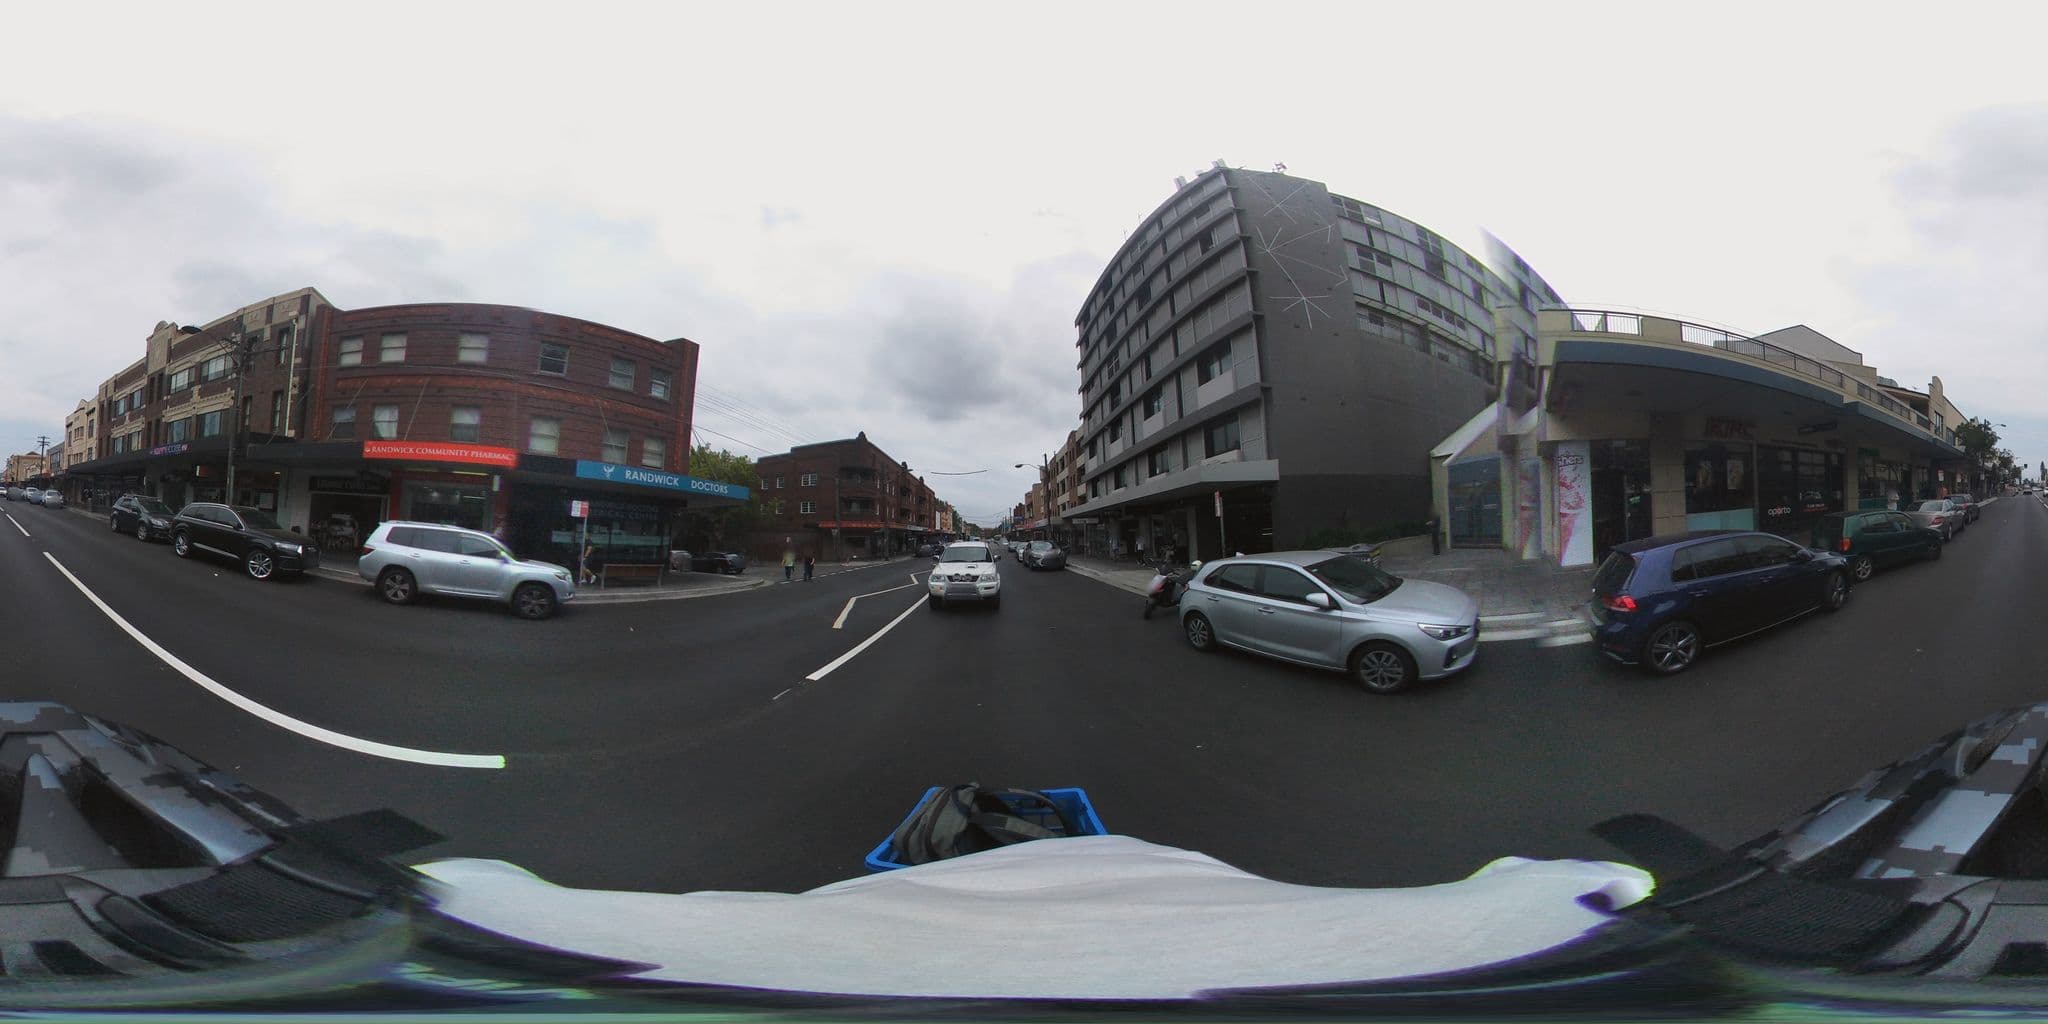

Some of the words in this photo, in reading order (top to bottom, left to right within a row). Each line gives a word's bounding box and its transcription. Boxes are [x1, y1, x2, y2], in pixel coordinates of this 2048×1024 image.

[371, 445, 414, 454] RANDWICK
[415, 447, 469, 457] COMMUNITY
[470, 450, 516, 461] PHARMAC
[625, 469, 680, 486] RANDWICK
[691, 480, 729, 494] DOCTORS
[1767, 507, 1791, 518] oporto
